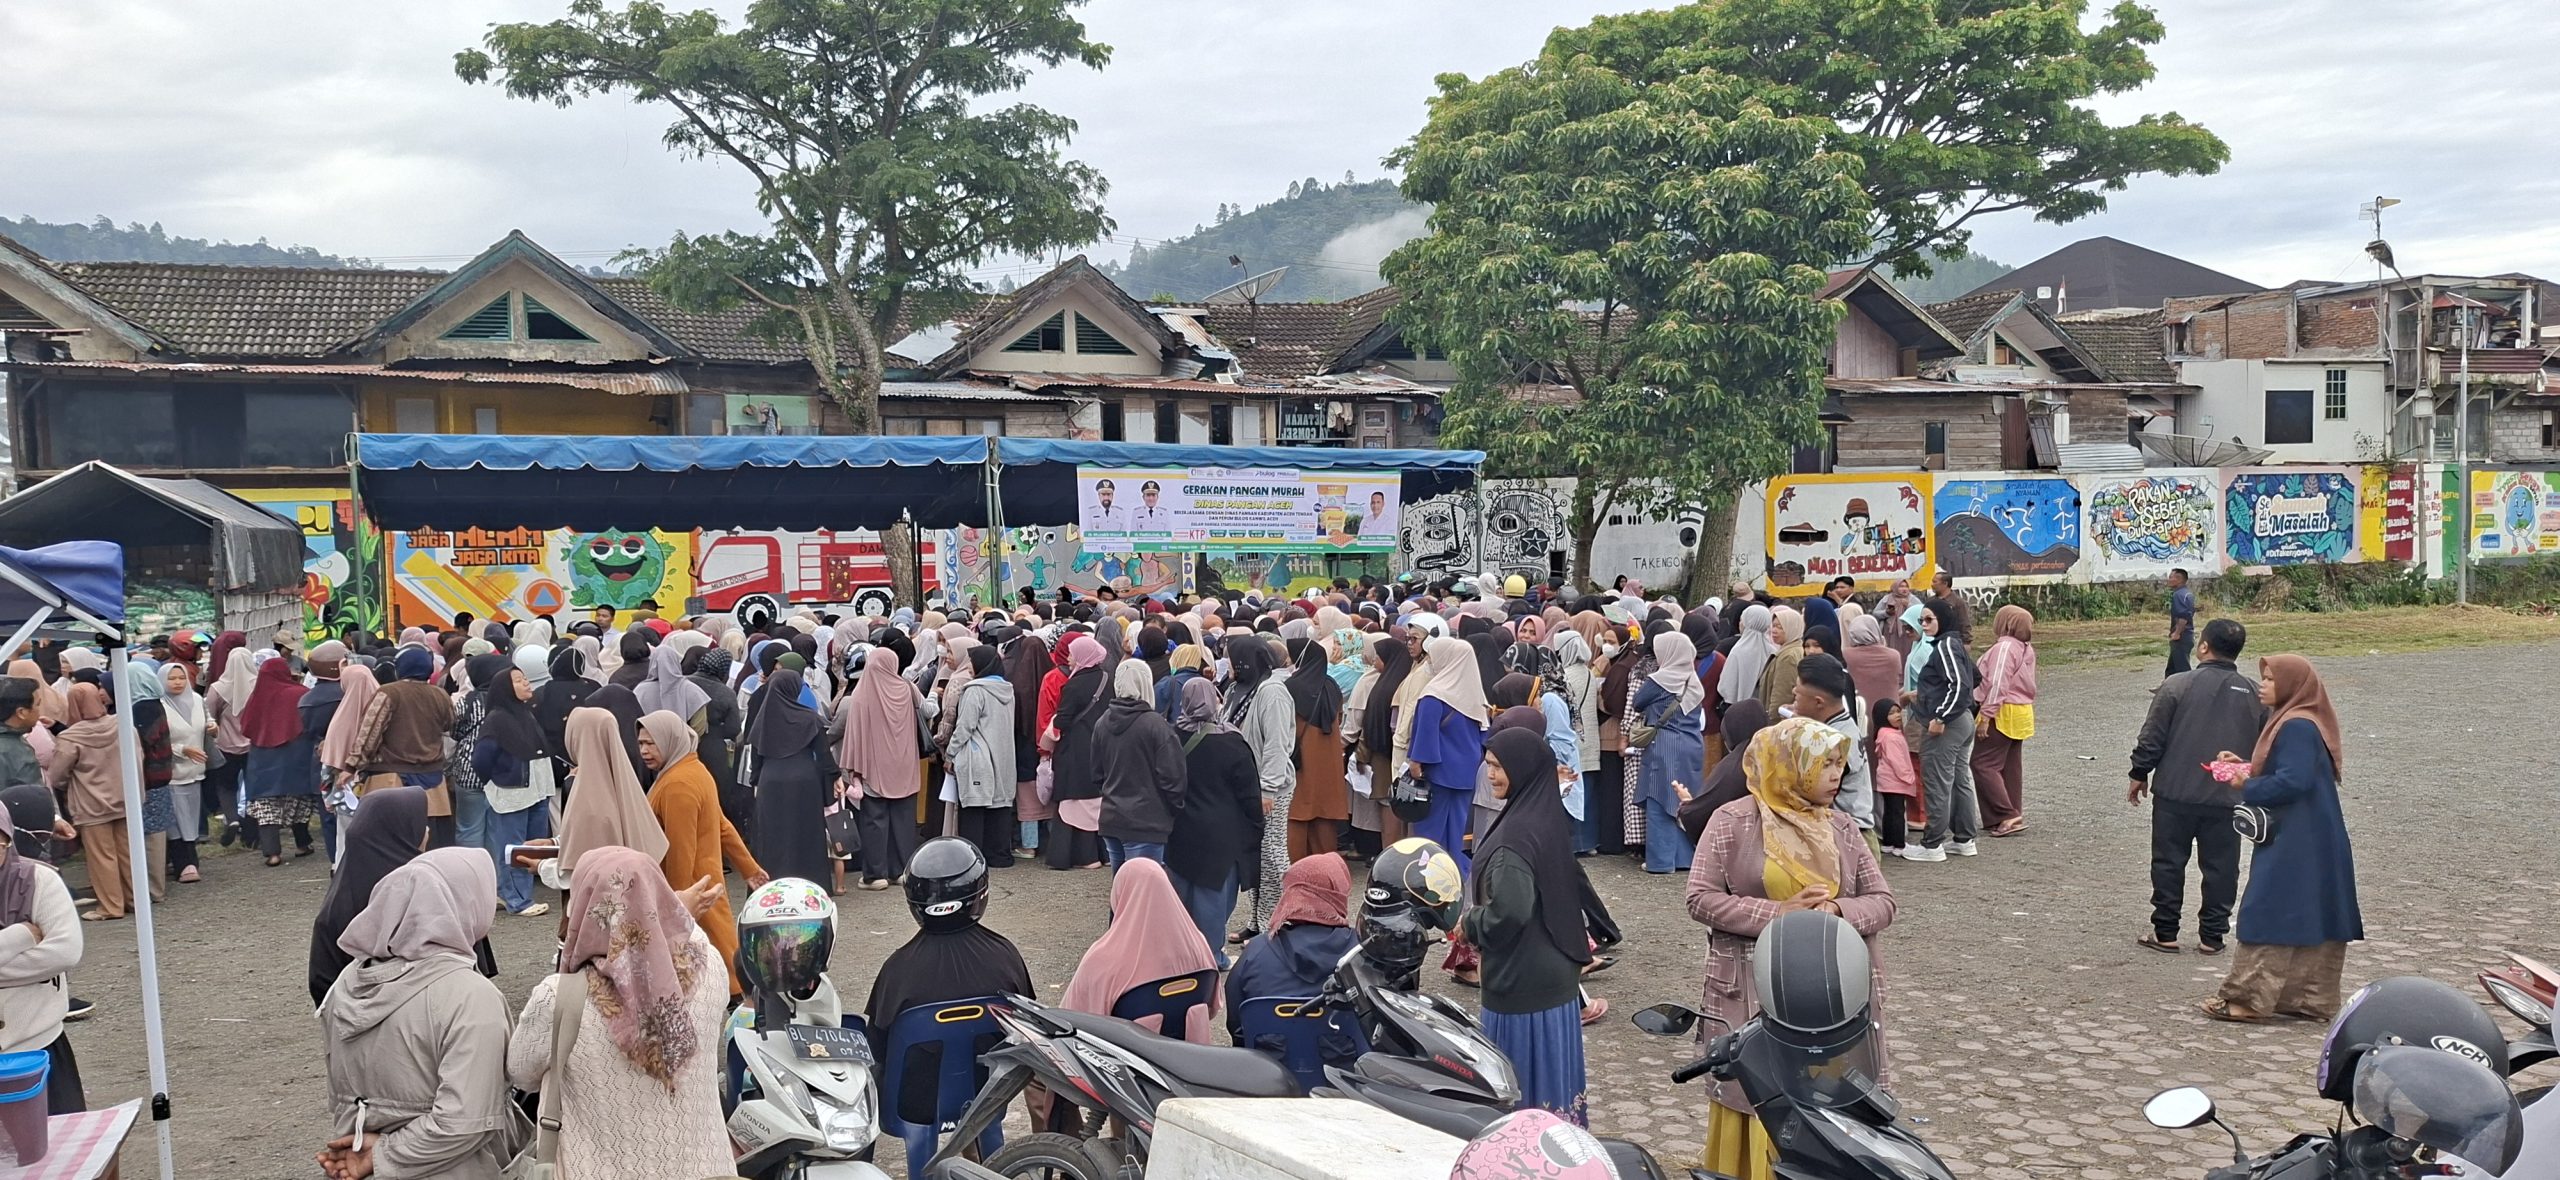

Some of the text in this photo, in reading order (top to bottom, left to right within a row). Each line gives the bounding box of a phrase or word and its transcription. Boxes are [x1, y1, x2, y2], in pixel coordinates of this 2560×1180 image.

[1183, 485, 1305, 497] GERAKAN PANGAN MURAH
[1194, 499, 1294, 510] DINAS PANGAN ACEH
[2140, 497, 2186, 527] SEBET
[2269, 513, 2328, 534] Masalah
[408, 534, 449, 548] JAGA
[1189, 529, 1206, 540] KTP
[452, 549, 538, 565] JAGA KITA
[1807, 554, 1907, 576] MARI BEKERJA
[933, 904, 955, 913] GM
[788, 1027, 807, 1042] BL
[2444, 1041, 2487, 1063] NCH
[1433, 1053, 1475, 1081] HONDA
[740, 1109, 771, 1135] HONDA
